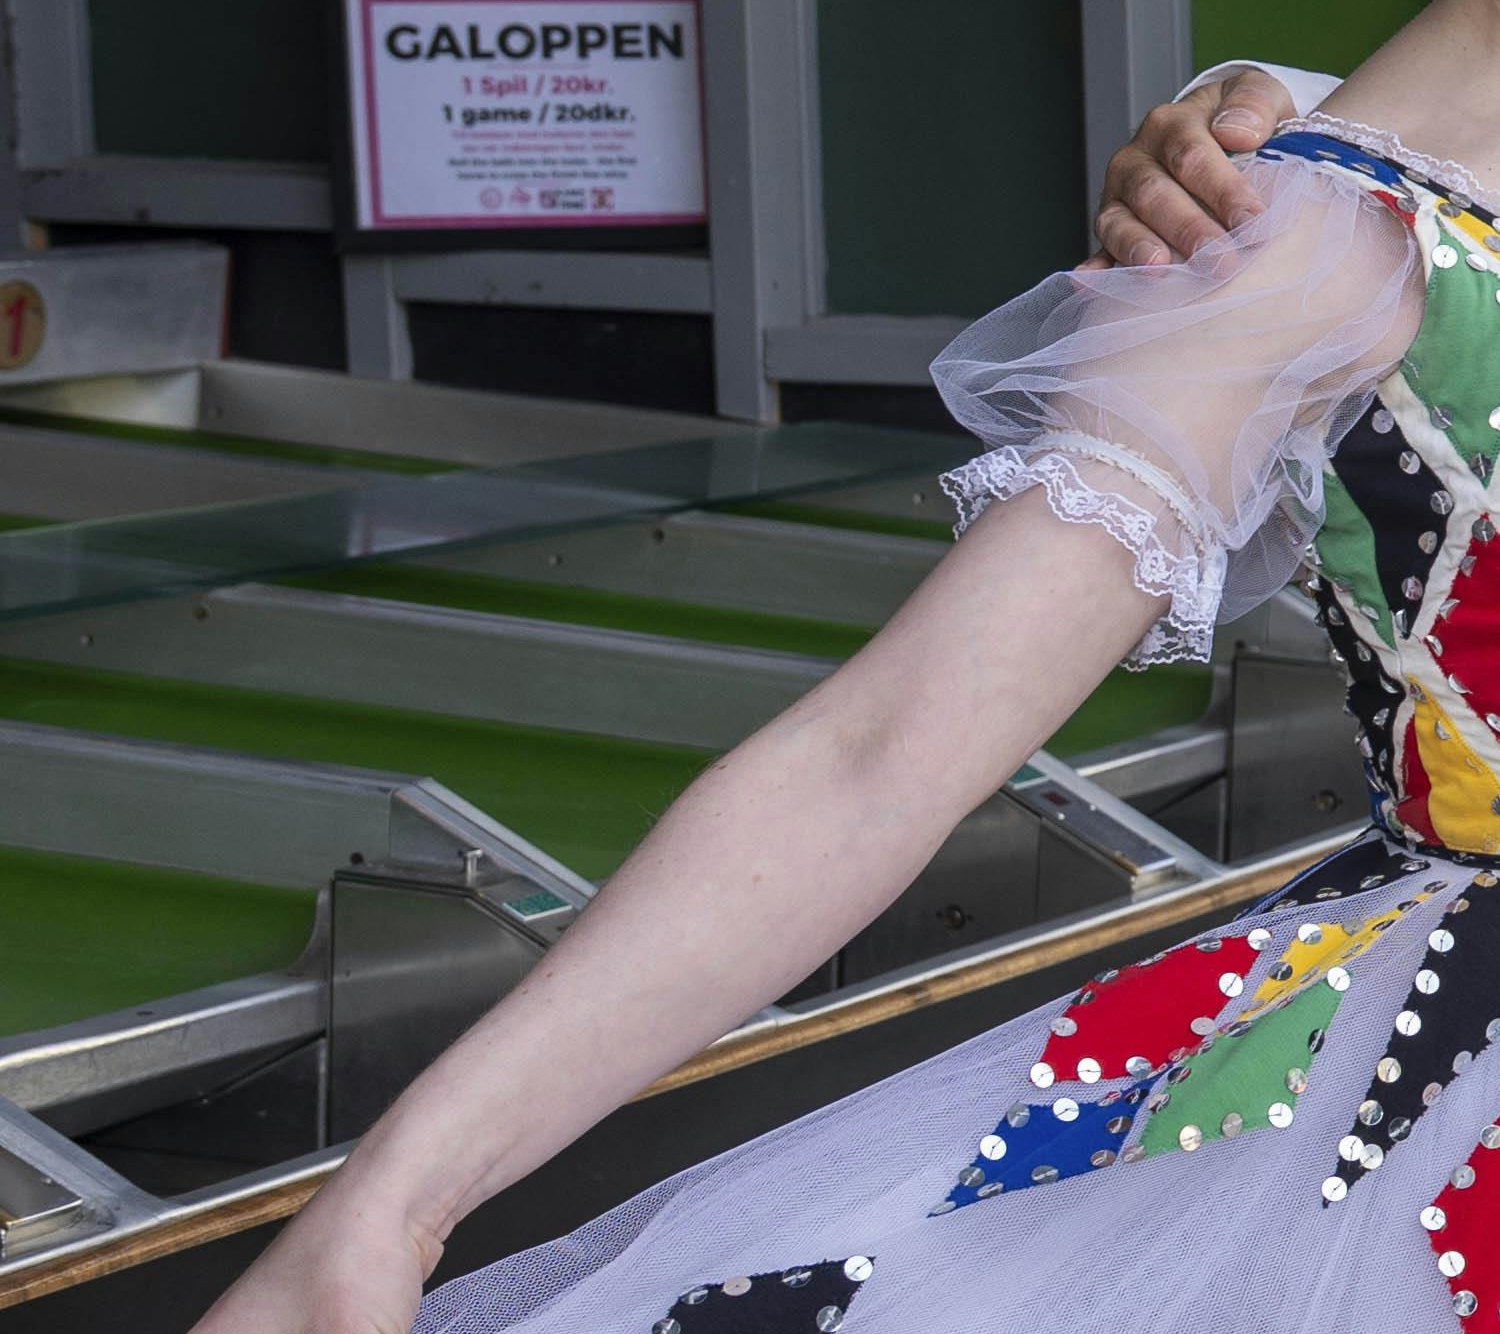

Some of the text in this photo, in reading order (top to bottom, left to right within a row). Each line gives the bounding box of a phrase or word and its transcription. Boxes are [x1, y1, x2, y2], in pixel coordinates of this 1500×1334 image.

[384, 21, 686, 61] GALOPPEN
[461, 75, 473, 94] 1
[480, 75, 528, 98] Spil
[534, 74, 546, 98] /
[442, 103, 637, 130] 1 game / 20dkr.
